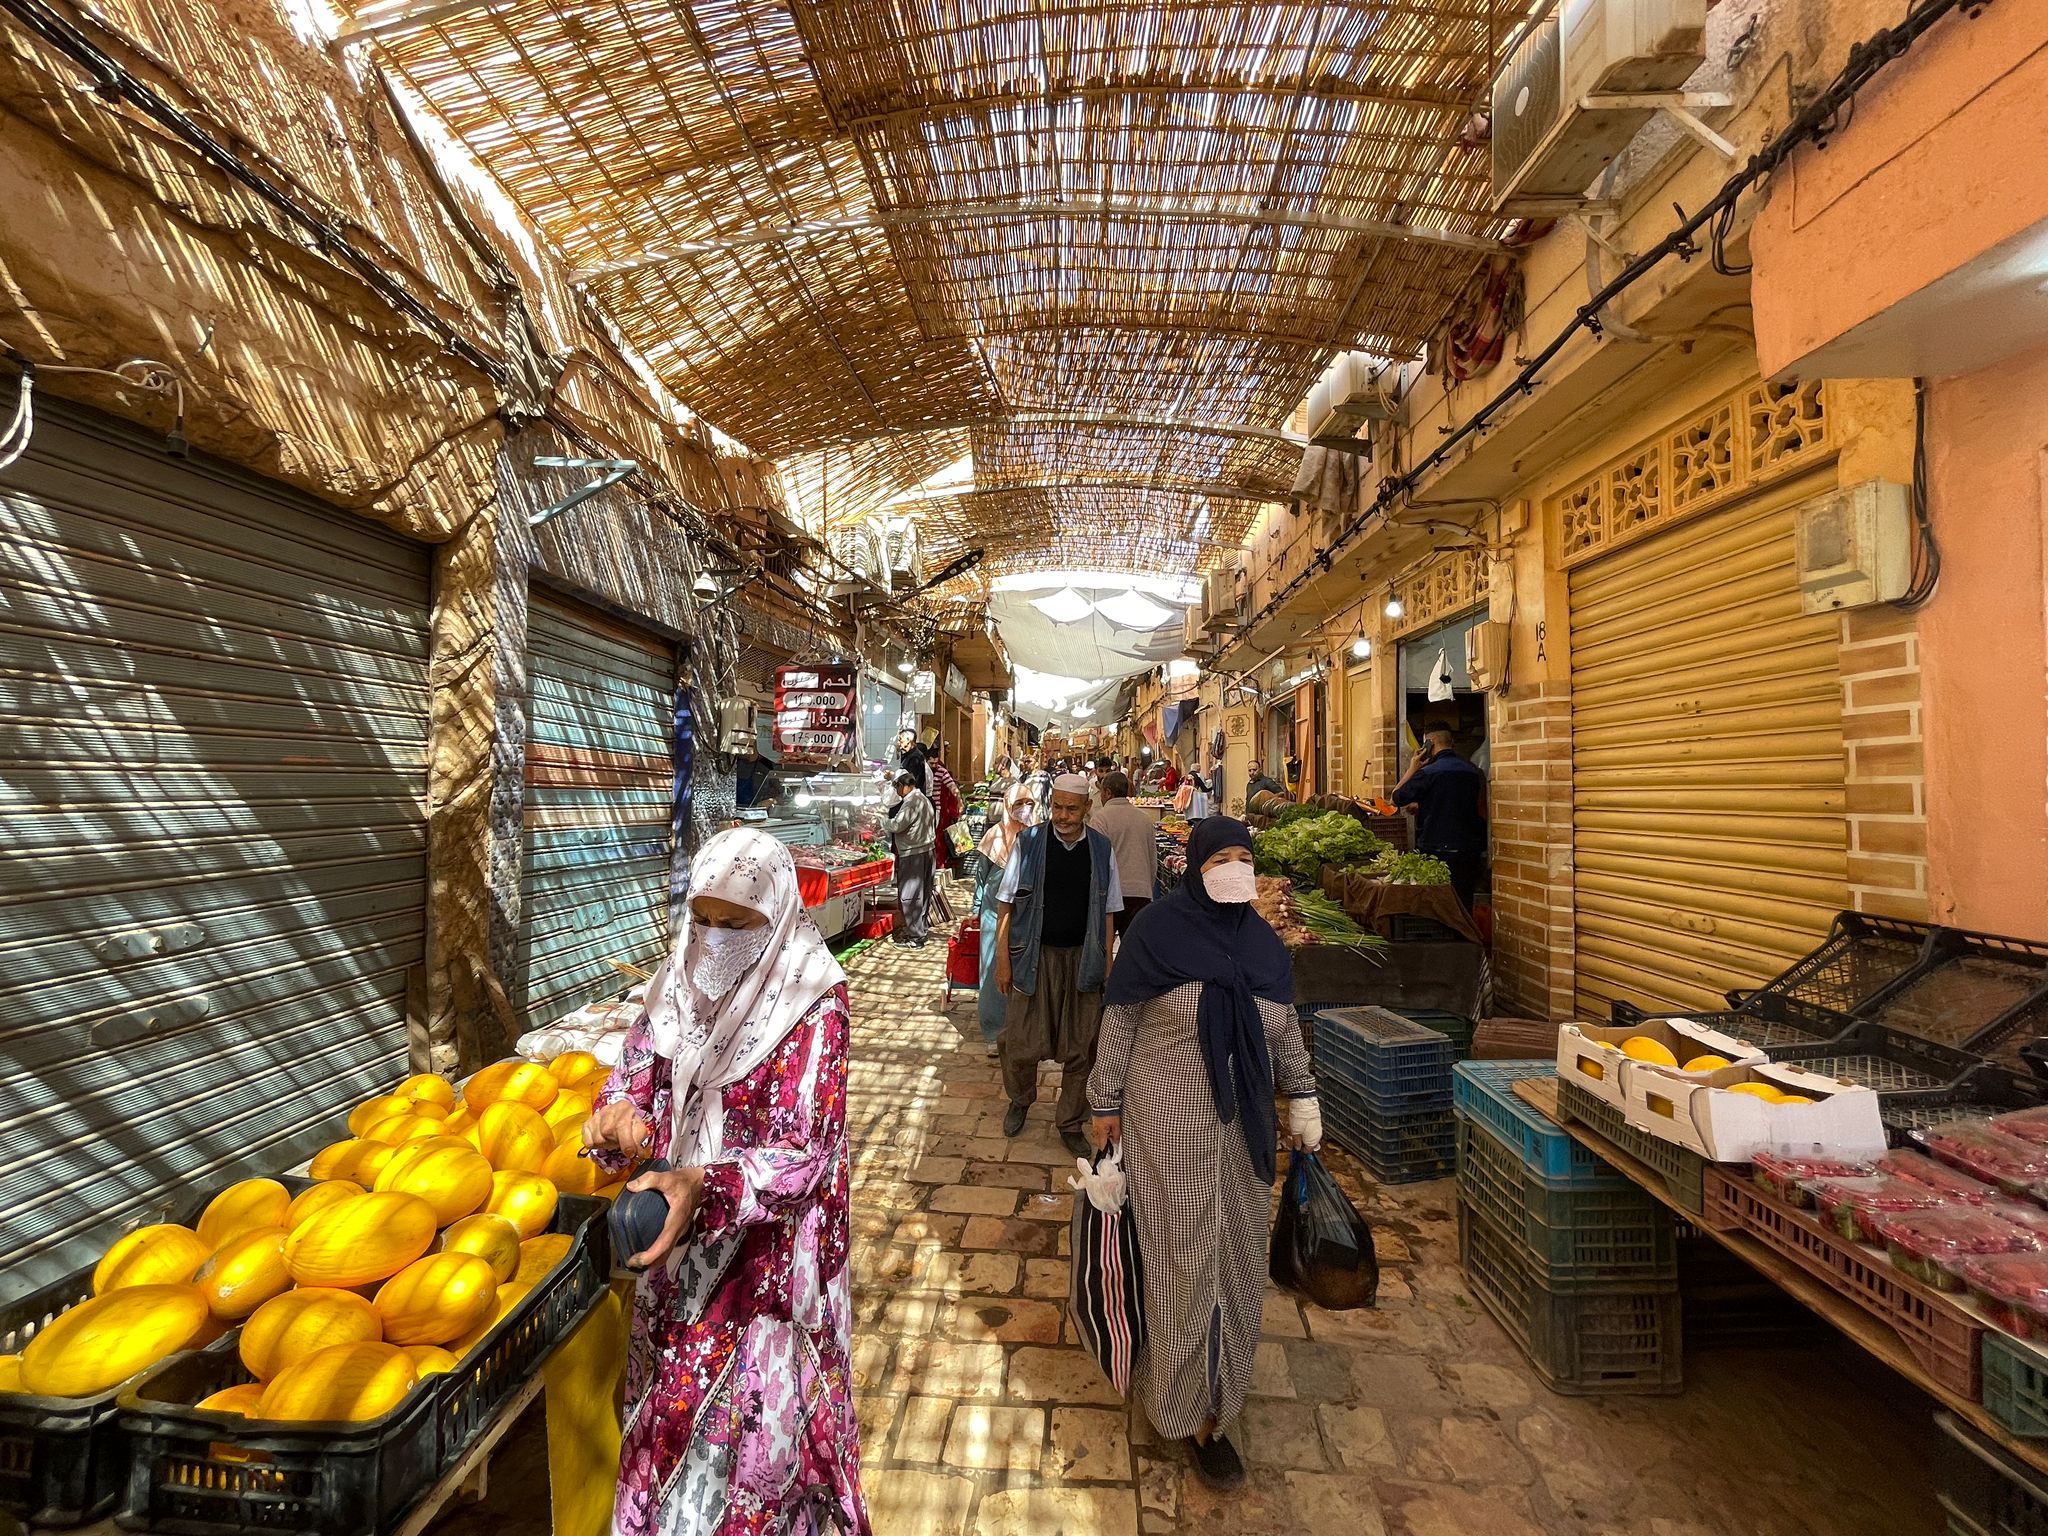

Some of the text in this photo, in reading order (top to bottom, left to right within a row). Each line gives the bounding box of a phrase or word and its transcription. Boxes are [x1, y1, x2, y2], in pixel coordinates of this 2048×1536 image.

[1535, 621, 1546, 641] 18
[1537, 642, 1547, 662] A
[822, 674, 851, 689] لحم
[820, 712, 850, 728] هبرة
